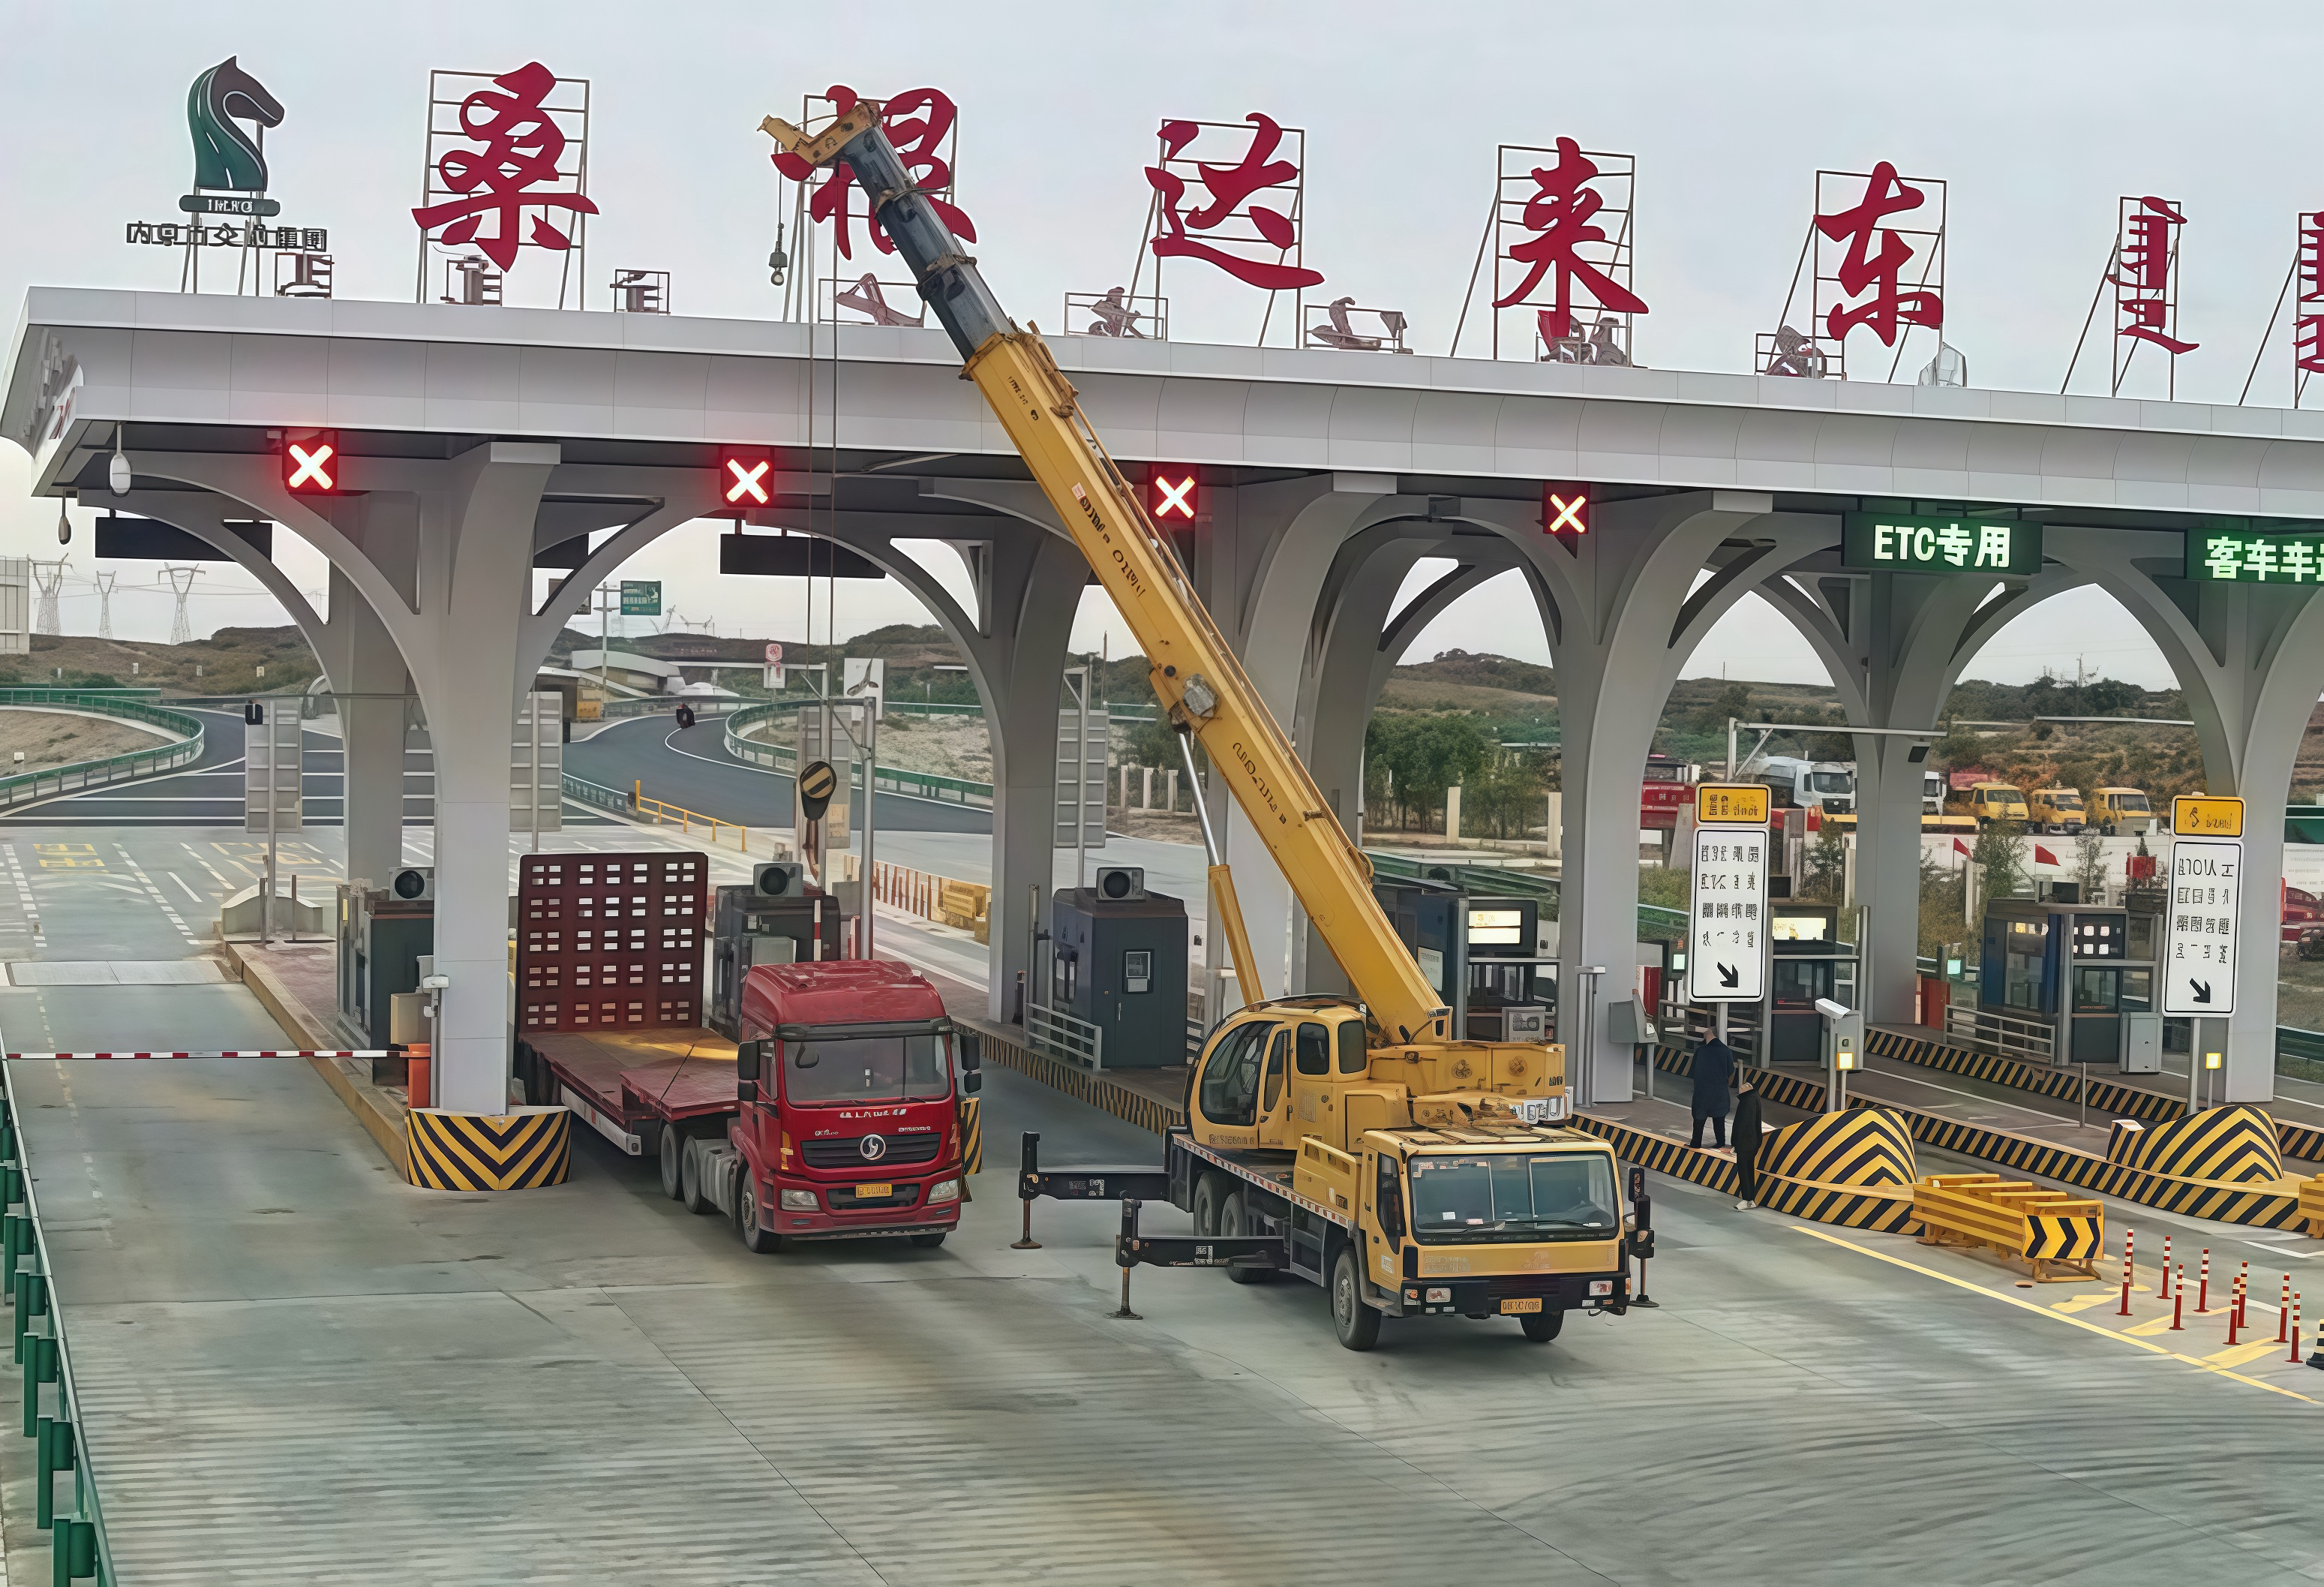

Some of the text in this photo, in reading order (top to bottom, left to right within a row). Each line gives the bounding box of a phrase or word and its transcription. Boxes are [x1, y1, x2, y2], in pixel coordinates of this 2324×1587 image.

[1874, 523, 2010, 568] ETC专用
[2205, 536, 2324, 582] 客车车
